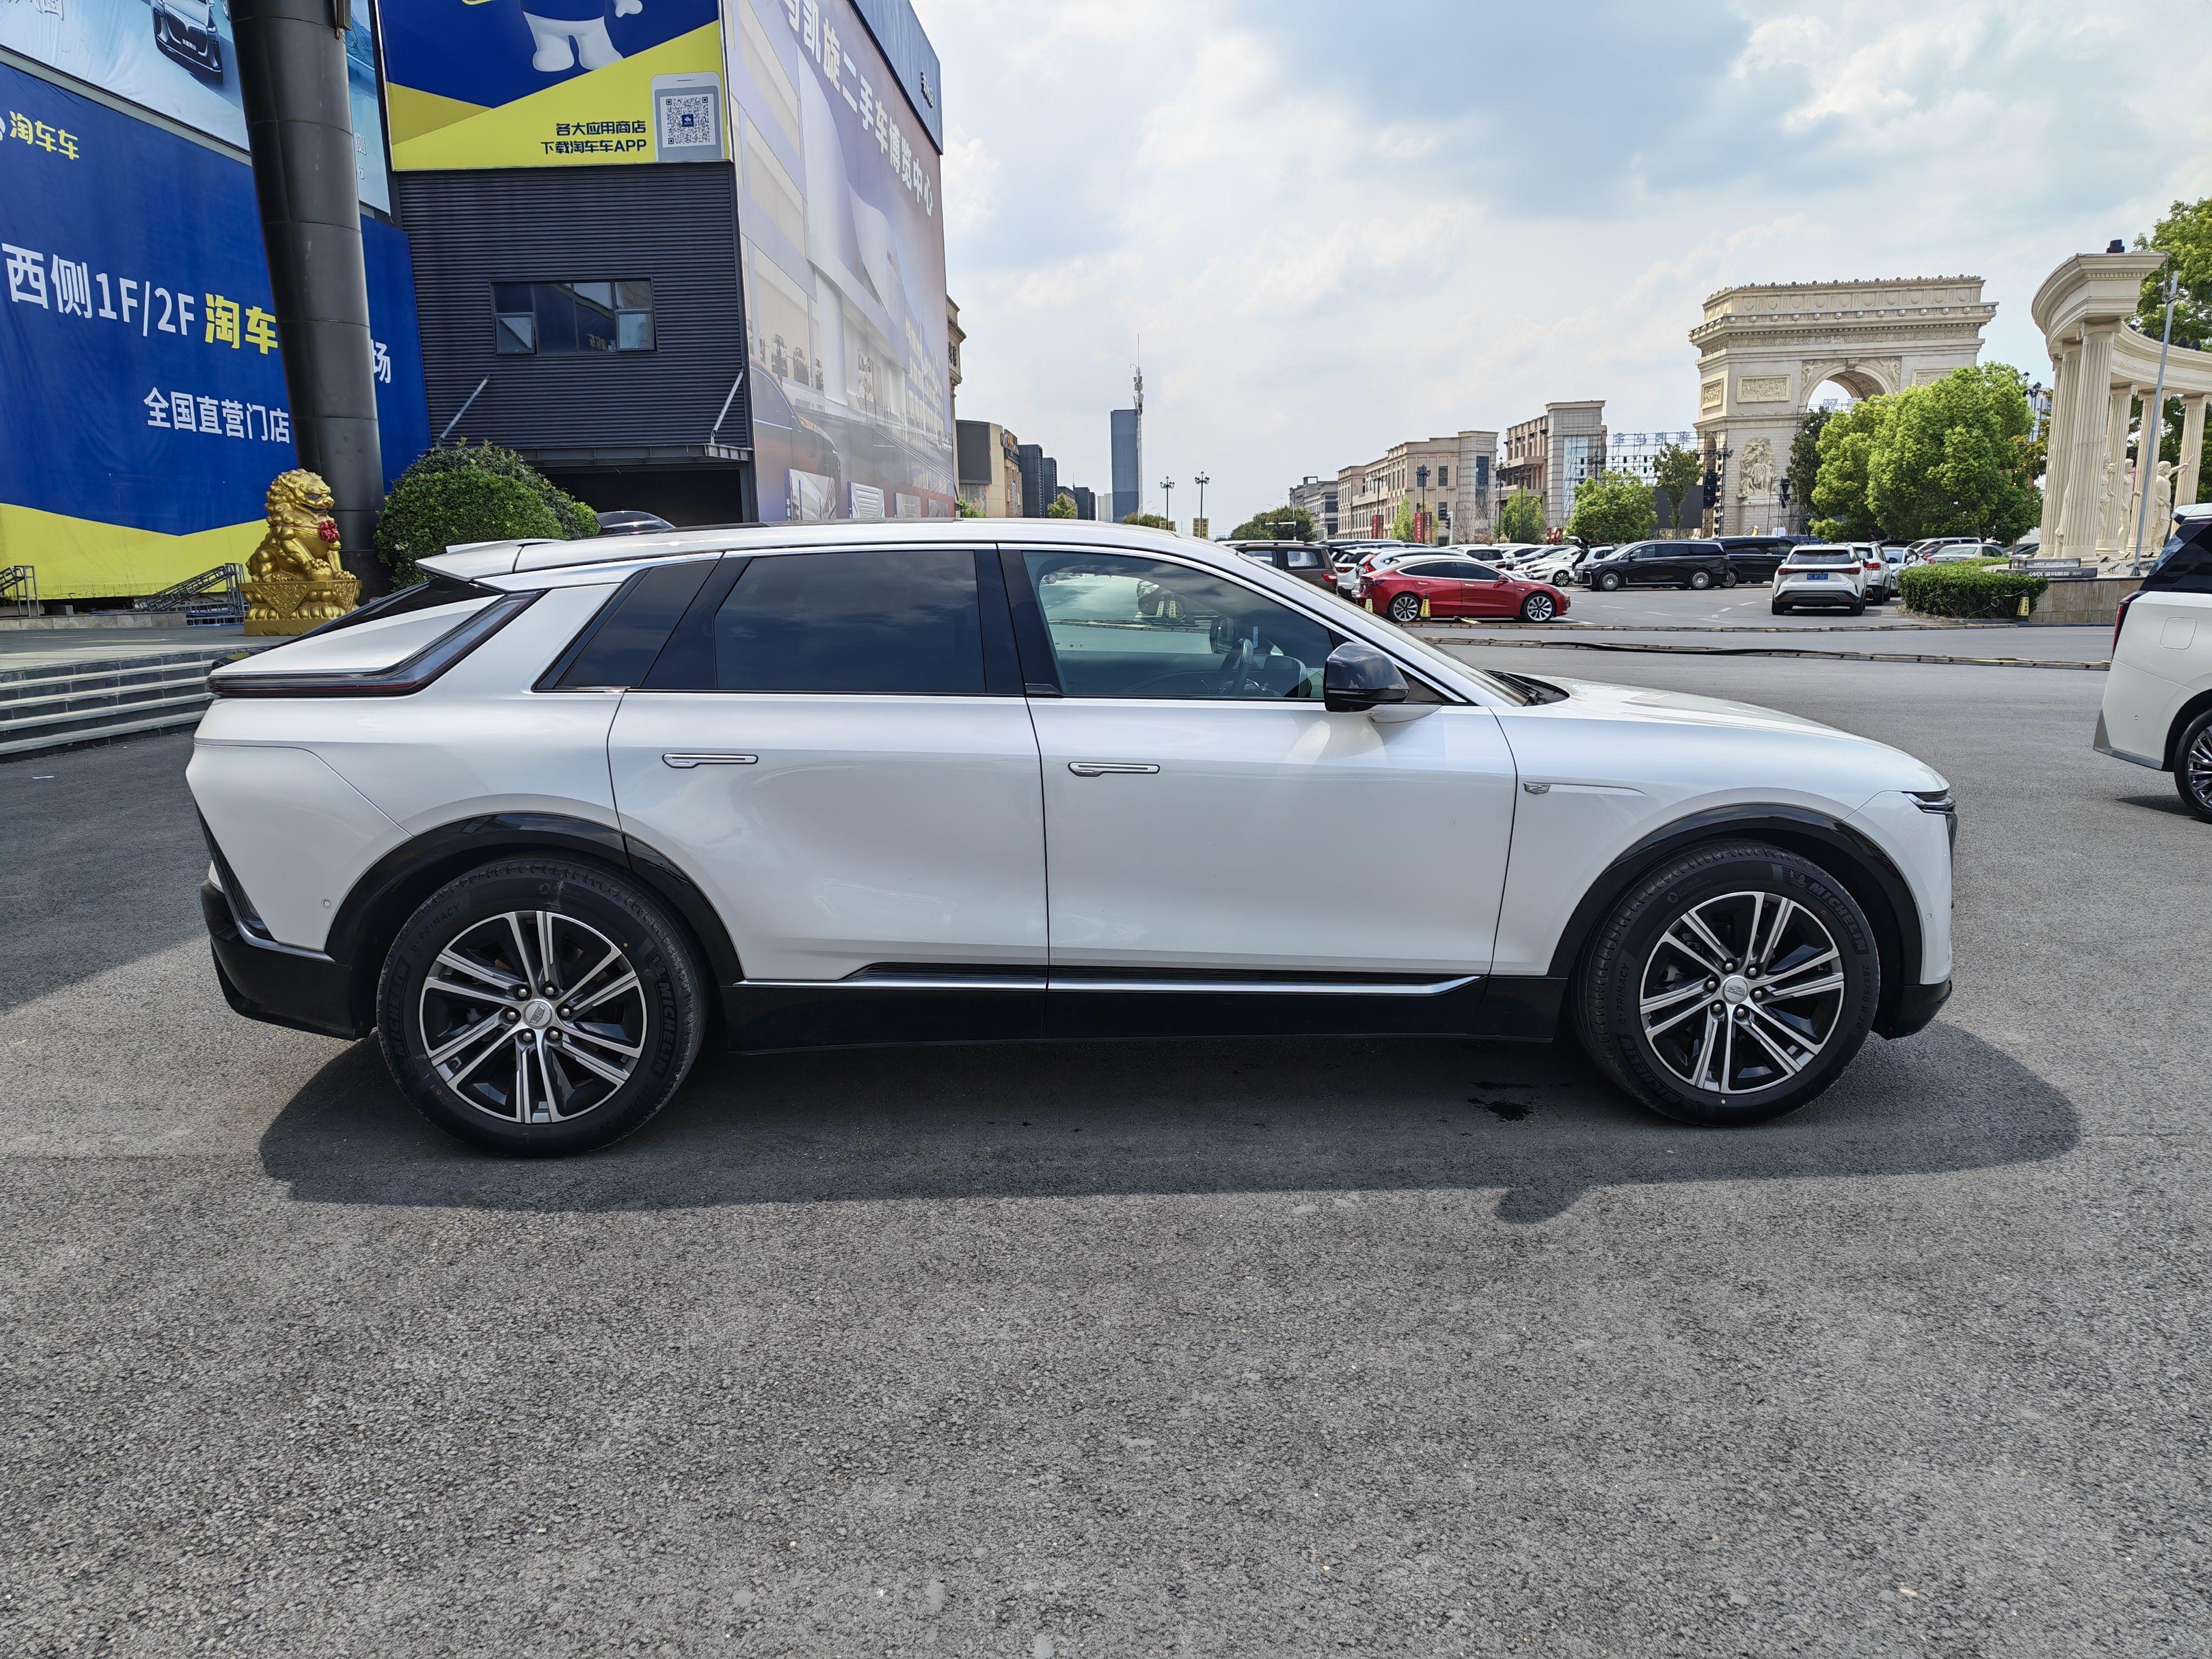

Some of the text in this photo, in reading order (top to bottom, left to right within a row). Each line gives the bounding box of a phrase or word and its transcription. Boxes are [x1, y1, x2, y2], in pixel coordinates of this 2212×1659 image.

[9, 110, 80, 160] 淘车车
[540, 139, 647, 155] 下载淘车车APP
[555, 120, 646, 136] 各大应用商店
[2, 242, 194, 337] 西侧1F/2F
[143, 386, 291, 444] 全国直营门店
[1614, 431, 1691, 444] 金马凯旋
[1808, 881, 1867, 952] MICHELIN
[653, 982, 676, 1078] MICHELIN
